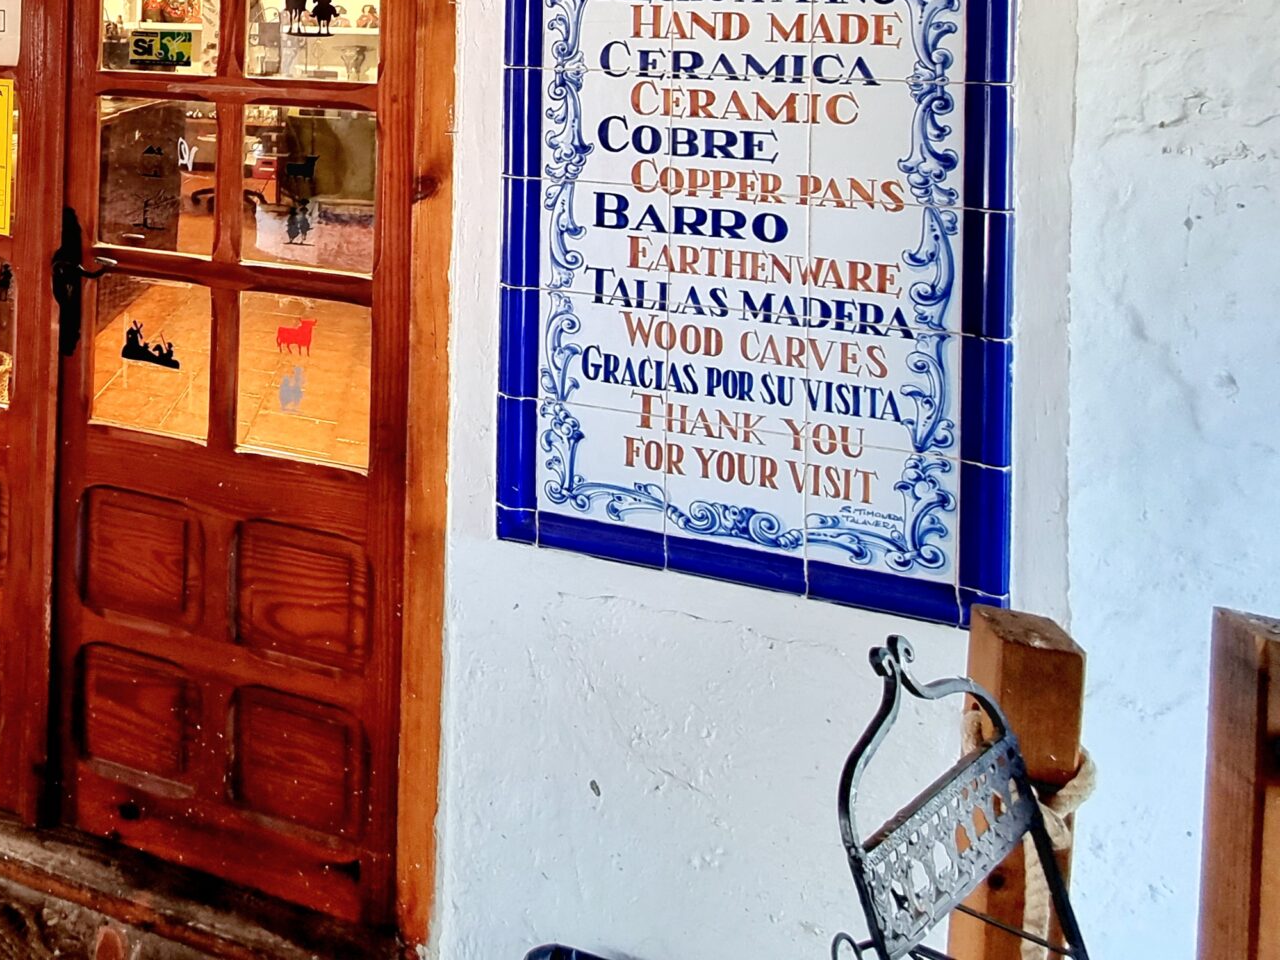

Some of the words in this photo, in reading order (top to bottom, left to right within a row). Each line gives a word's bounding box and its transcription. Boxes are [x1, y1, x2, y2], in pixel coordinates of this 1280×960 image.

[133, 37, 155, 57] Sí
[630, 4, 751, 41] HAND
[765, 11, 904, 50] MADE
[599, 40, 882, 87] CERAMICA
[630, 79, 860, 126] CERAMIC
[597, 114, 779, 164] COBRE
[631, 158, 787, 206] COPPER
[795, 173, 906, 213] PANS
[593, 191, 789, 244] BARRO
[626, 234, 903, 299] EARTHENWARE
[583, 264, 729, 319] TALLAS
[738, 289, 919, 340] MADERA
[619, 310, 724, 358] WOOD
[739, 330, 889, 380] CARVES
[580, 344, 699, 396] GRACIAS
[705, 366, 755, 403] POR
[760, 371, 795, 408] SU
[799, 376, 904, 424] VISITA
[630, 389, 767, 446] THANK
[779, 416, 865, 459] YOU
[623, 435, 687, 477] FOR
[692, 445, 780, 491] YOUR
[784, 459, 880, 506] VISIT
